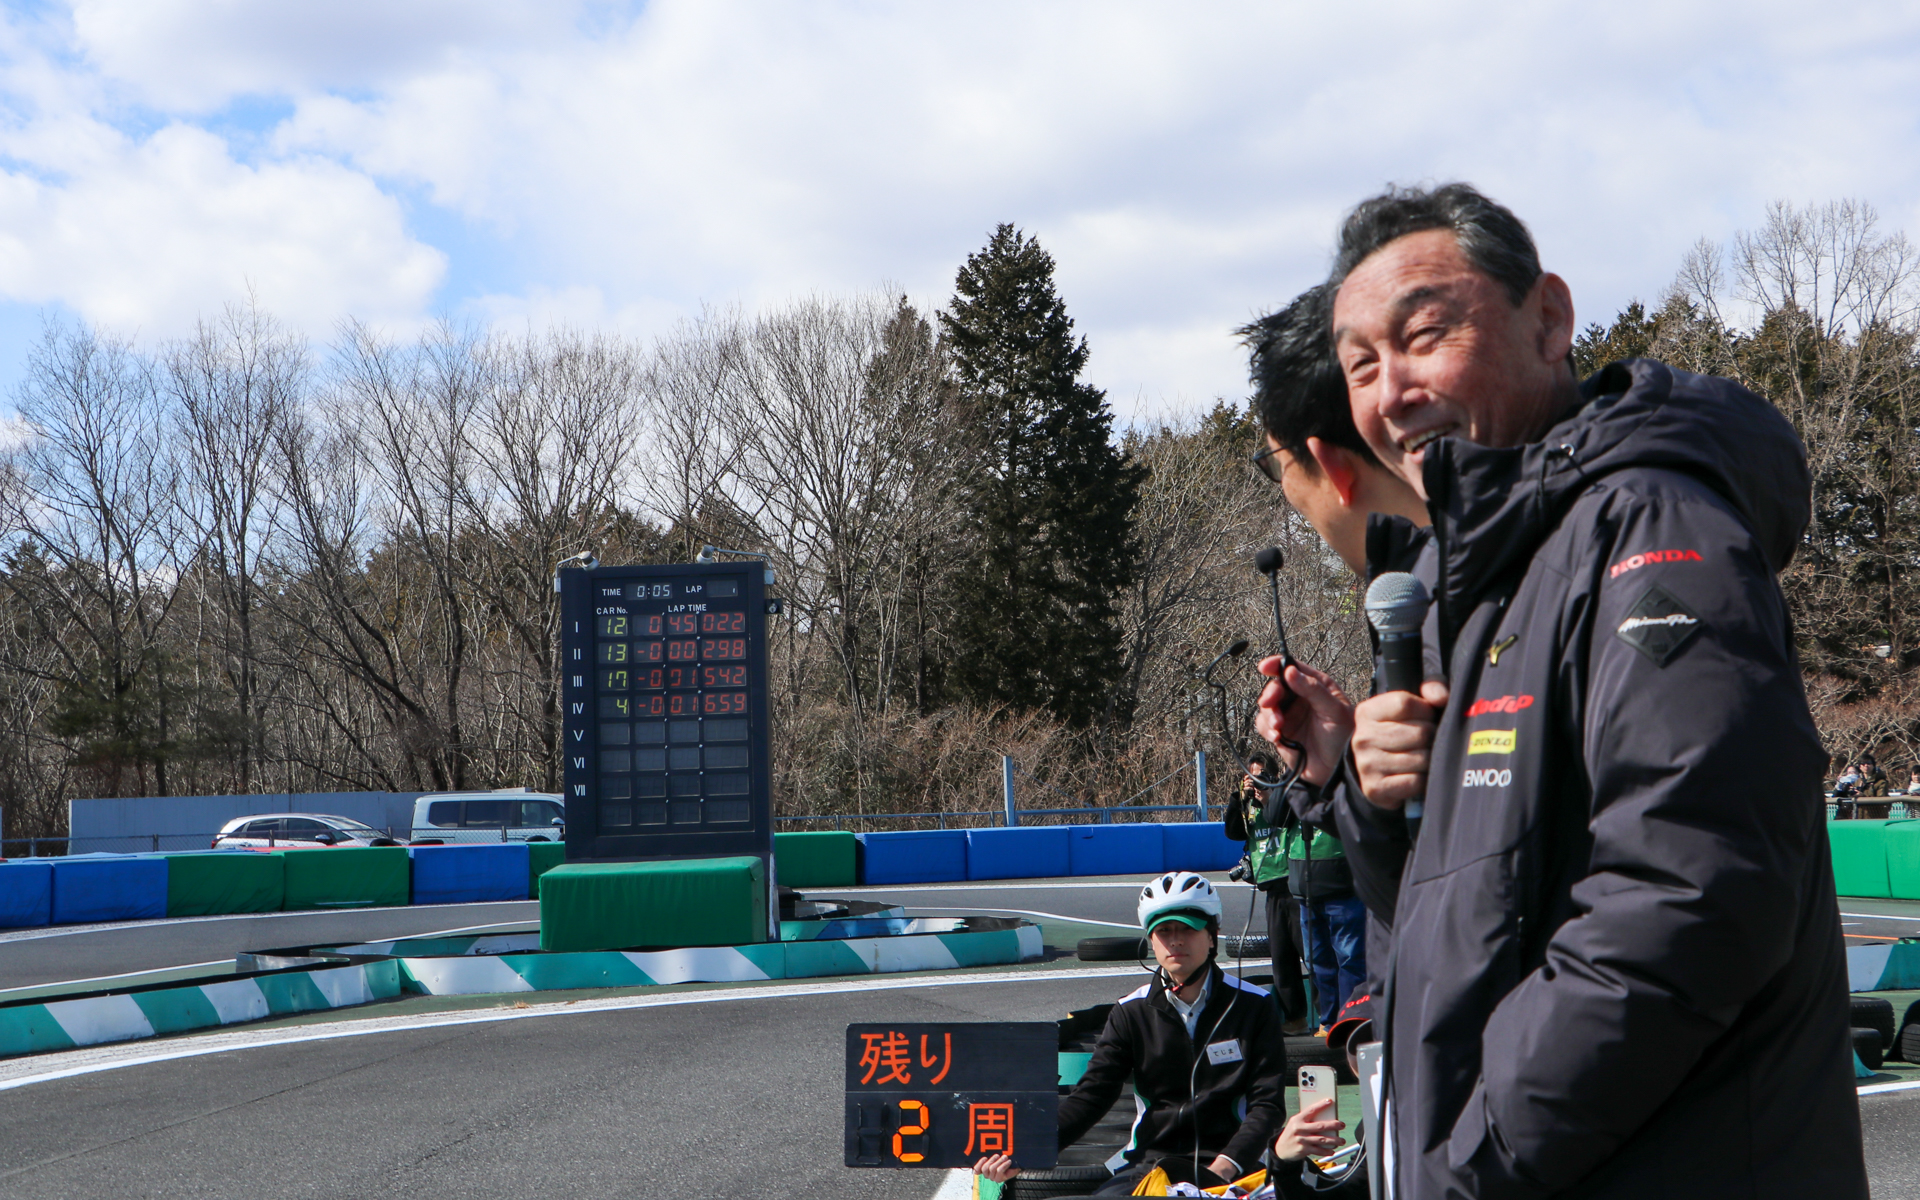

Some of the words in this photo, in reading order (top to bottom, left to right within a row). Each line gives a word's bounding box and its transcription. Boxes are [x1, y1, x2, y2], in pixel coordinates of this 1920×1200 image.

[1609, 549, 1704, 579] HONDA
[602, 588, 621, 596] TIME
[637, 584, 671, 598] 0:05
[685, 585, 703, 593] LAP
[596, 607, 615, 615] CAR
[616, 606, 628, 614] No.
[668, 605, 685, 613] LAP
[688, 604, 707, 612] TIME
[607, 617, 626, 635] 12
[607, 643, 627, 661] 13
[573, 675, 583, 687] III
[608, 670, 627, 688] 17
[572, 702, 584, 715] IV
[616, 698, 628, 715] 4
[573, 729, 584, 742] V
[1473, 736, 1513, 747] DUNLO
[573, 757, 585, 769] VI
[574, 784, 586, 796] VII
[858, 1031, 952, 1085] 残り
[892, 1099, 930, 1163] 2
[963, 1102, 1014, 1157] 周
